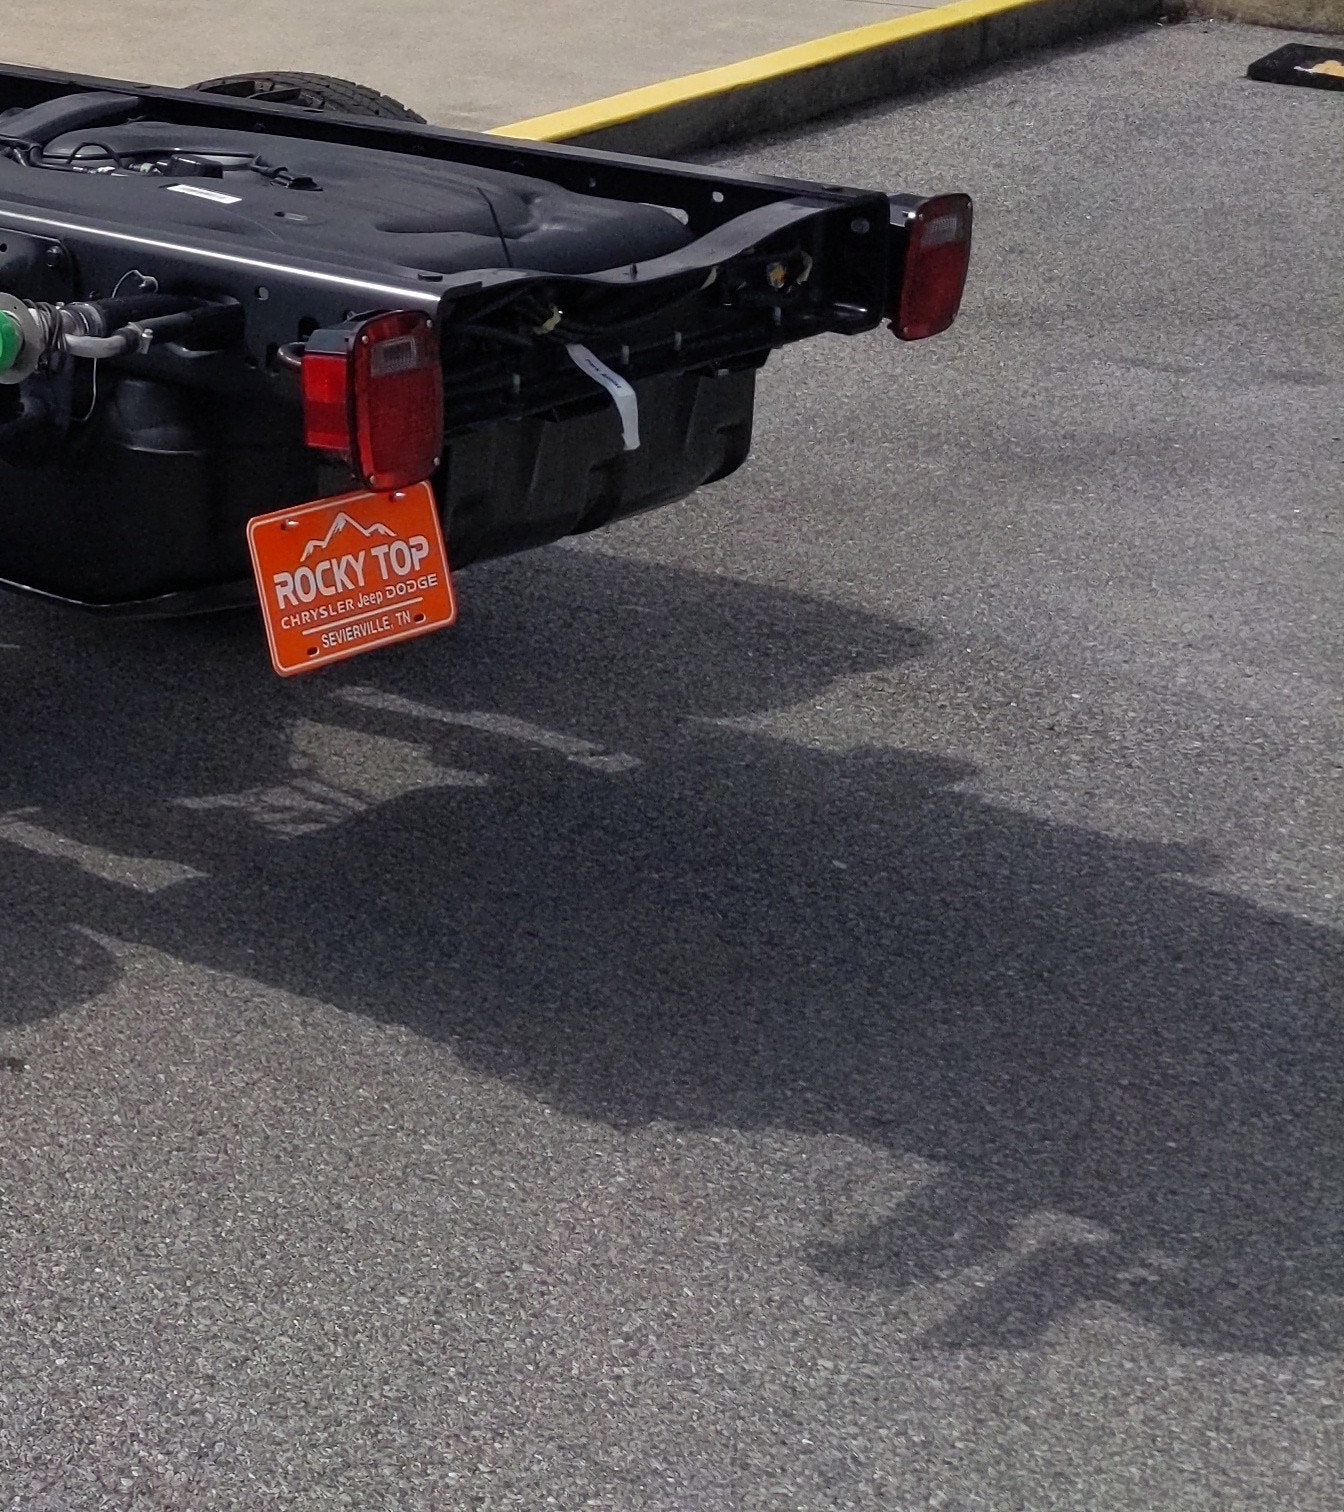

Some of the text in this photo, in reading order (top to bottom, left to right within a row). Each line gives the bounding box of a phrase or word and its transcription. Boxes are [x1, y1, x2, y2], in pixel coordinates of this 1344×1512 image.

[273, 535, 429, 610] ROCKY TOP
[281, 573, 438, 630] CHRYSLER Jeep DODGE
[321, 610, 411, 648] SEVIERVILLE, TN
